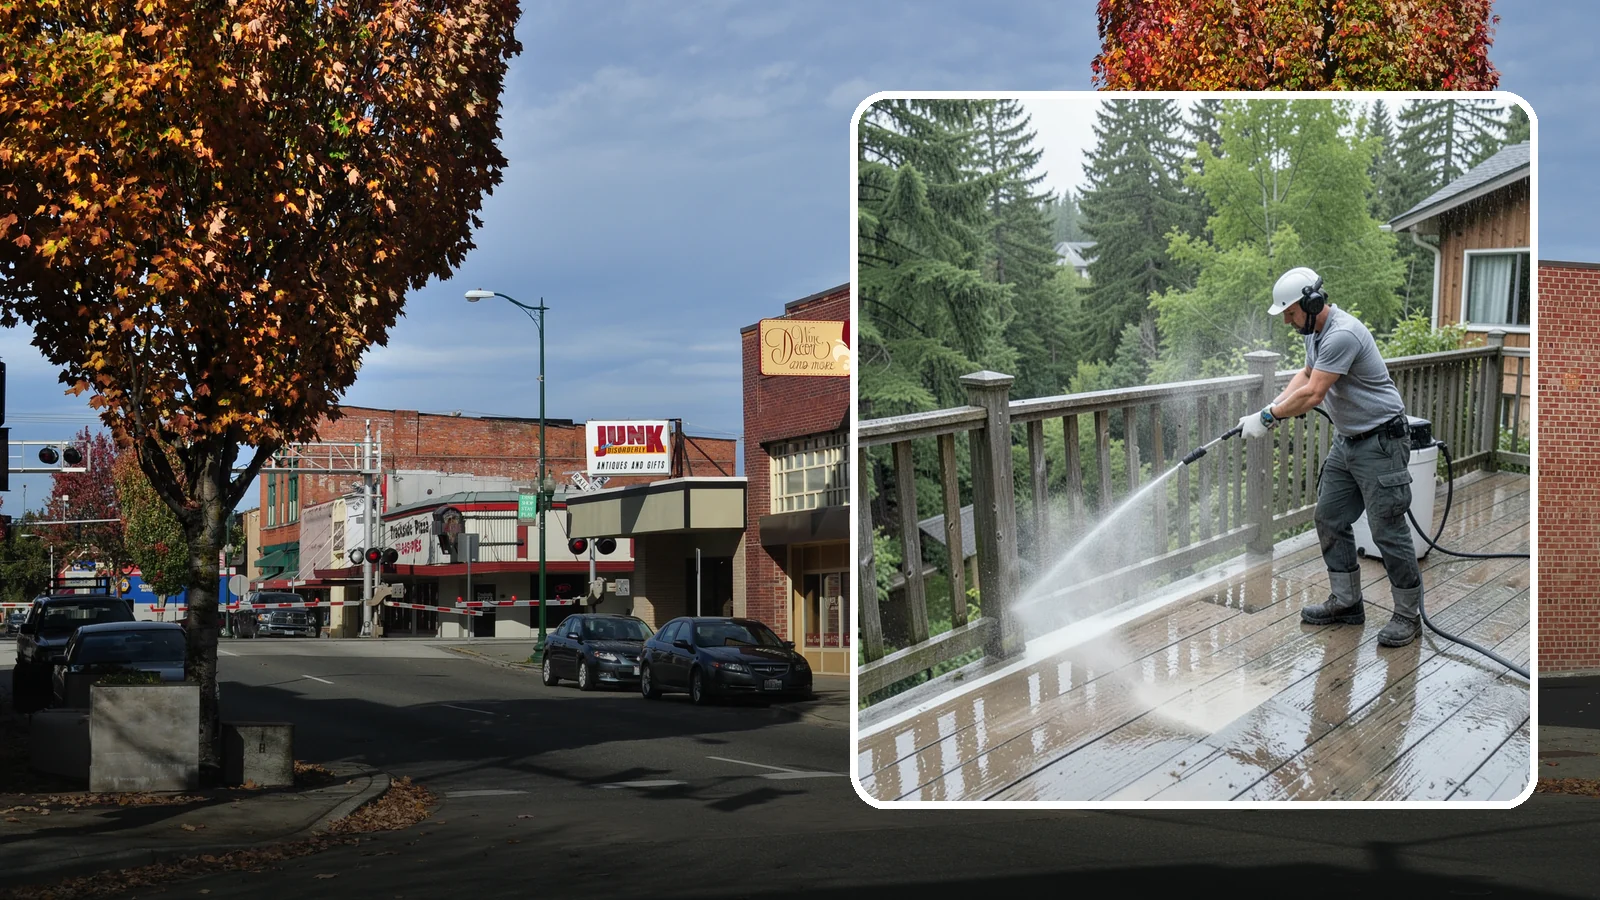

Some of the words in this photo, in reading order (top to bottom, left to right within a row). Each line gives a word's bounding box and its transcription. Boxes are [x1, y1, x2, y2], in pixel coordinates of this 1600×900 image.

[595, 425, 665, 457] JUNK
[607, 446, 646, 454] DISORDERLY
[597, 461, 628, 470] ANTIQUES
[631, 461, 644, 470] AND
[647, 460, 665, 469] GIFTS
[414, 519, 429, 535] Pizza
